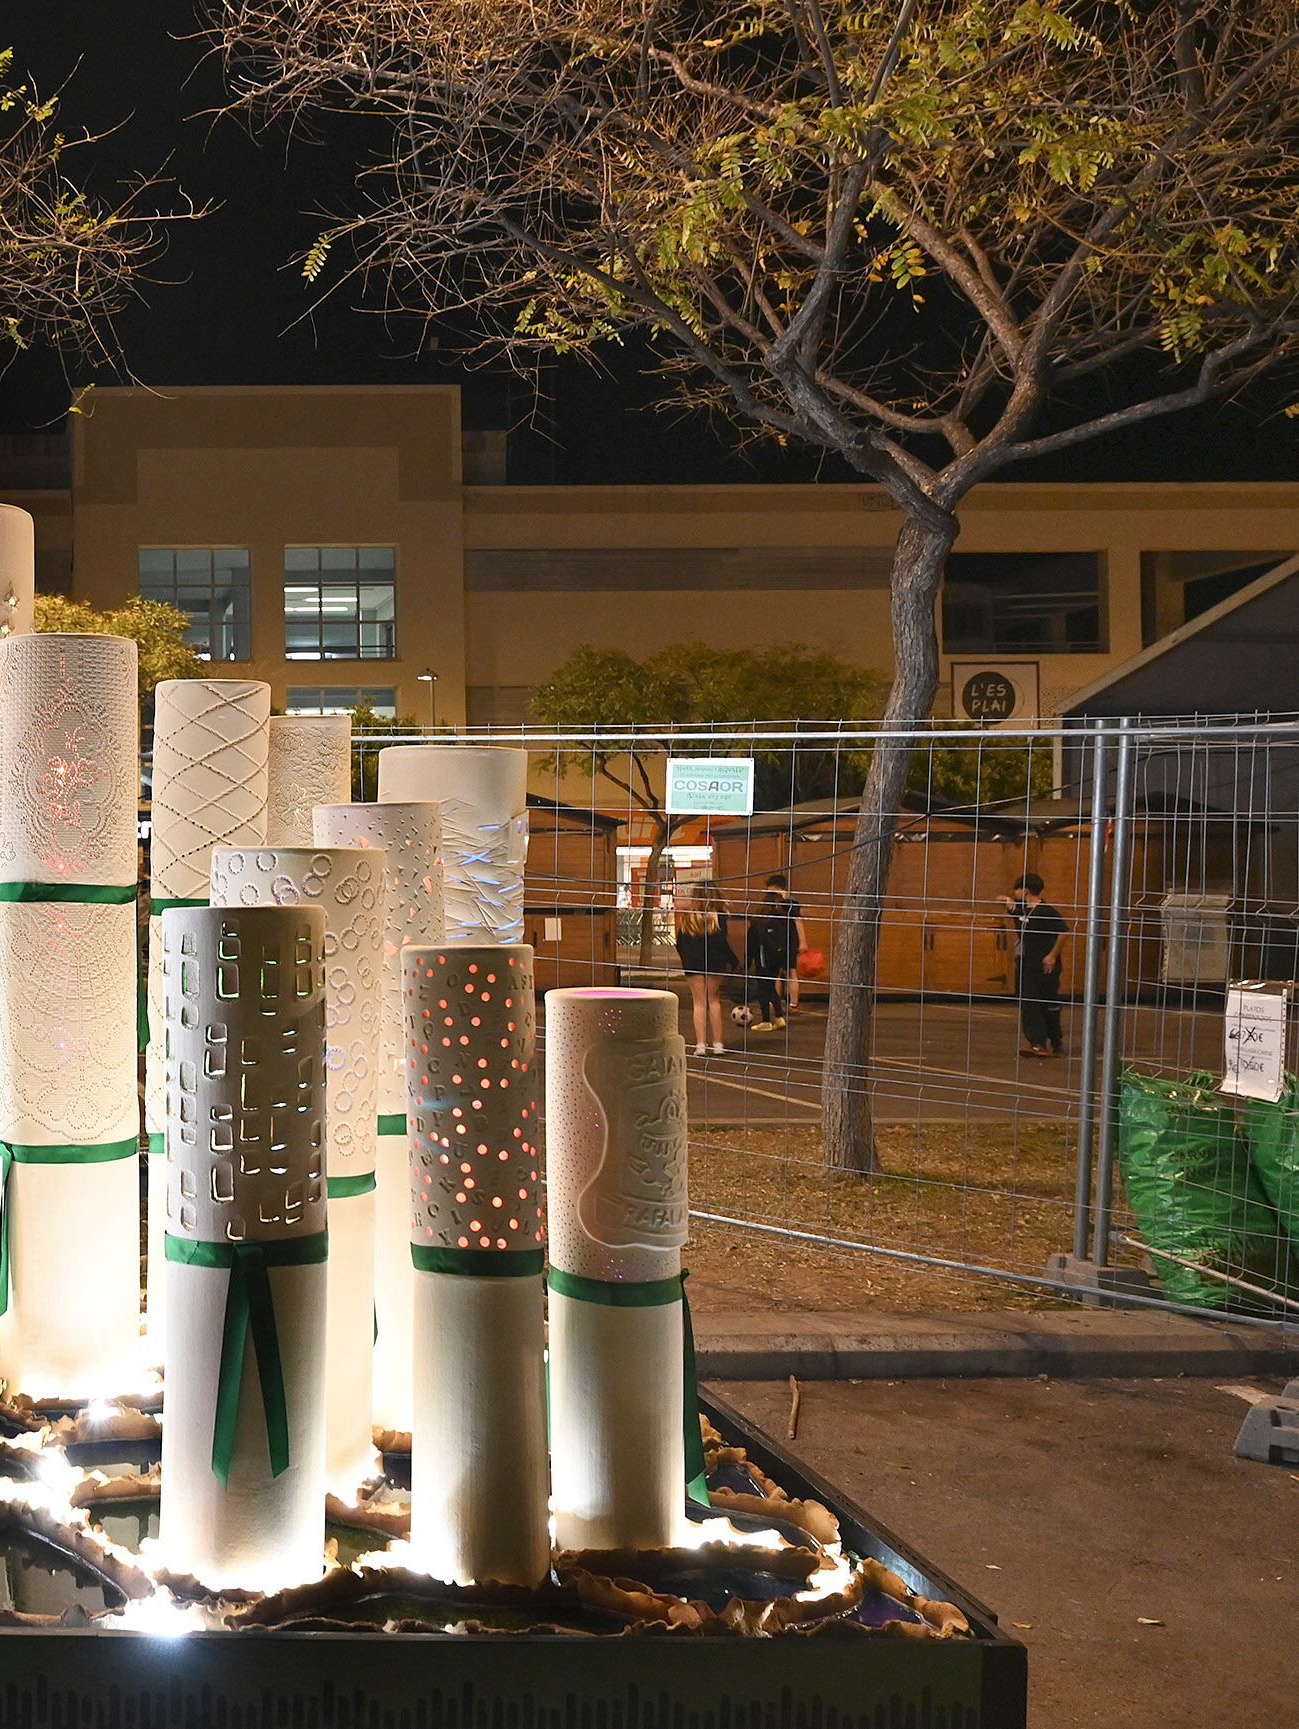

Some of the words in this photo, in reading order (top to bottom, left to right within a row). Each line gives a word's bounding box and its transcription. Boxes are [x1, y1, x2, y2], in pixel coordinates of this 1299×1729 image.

[971, 683, 1006, 697] L'ES
[971, 699, 1006, 712] PLAI
[673, 780, 744, 792] COSAOR
